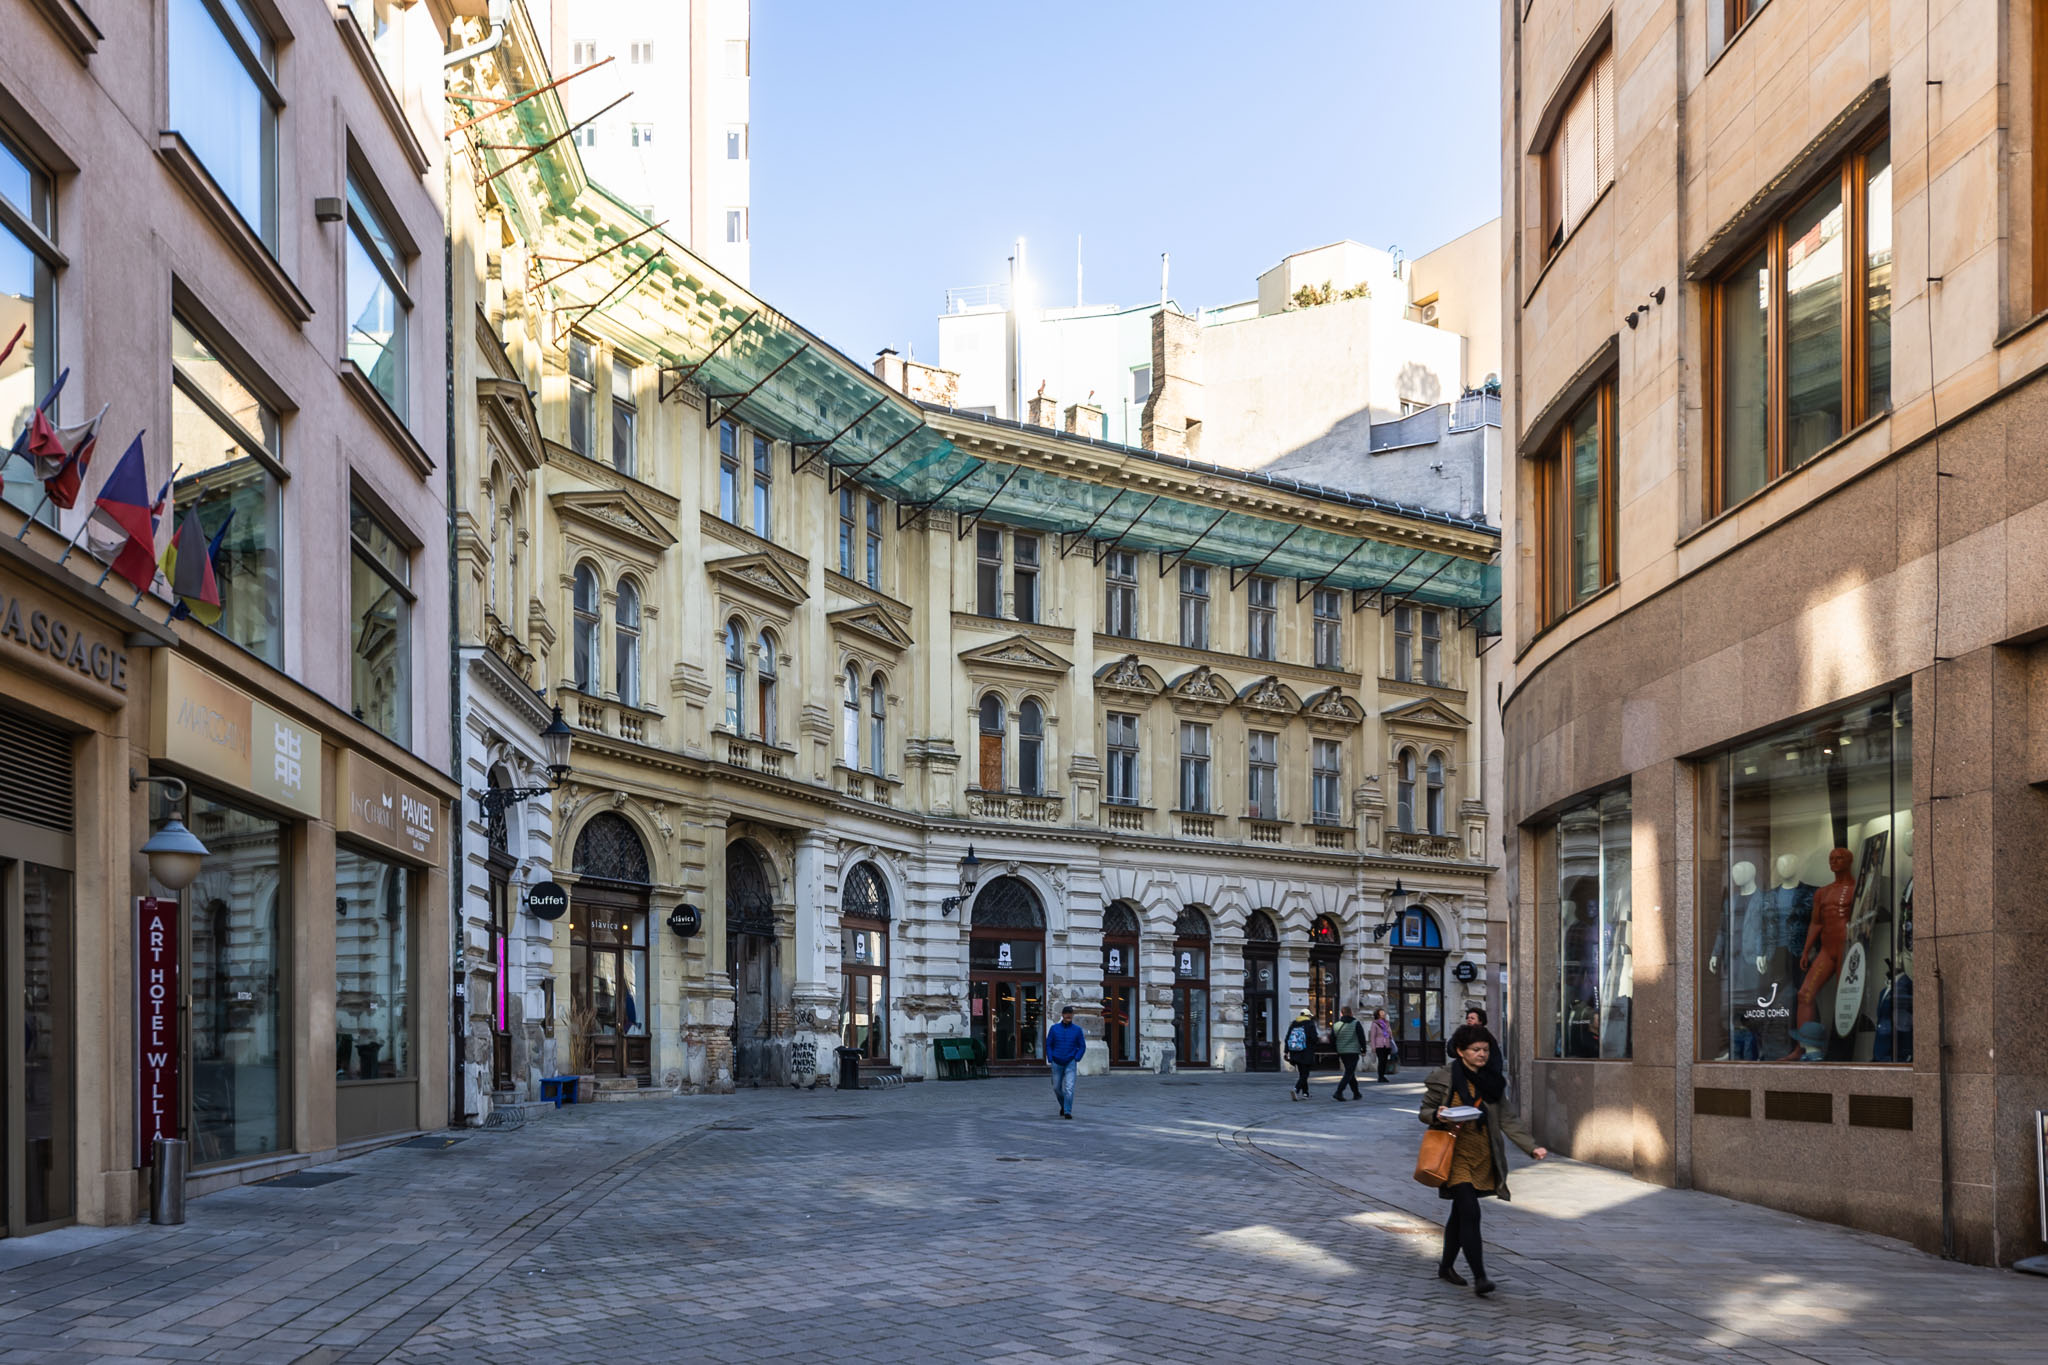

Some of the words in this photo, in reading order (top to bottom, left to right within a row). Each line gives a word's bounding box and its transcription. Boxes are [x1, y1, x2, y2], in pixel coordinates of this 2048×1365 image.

[402, 794, 434, 832] PAVIEL
[530, 895, 564, 905] Buffet
[149, 969, 165, 1046] HOTEL
[1744, 1009, 1766, 1019] JACOB
